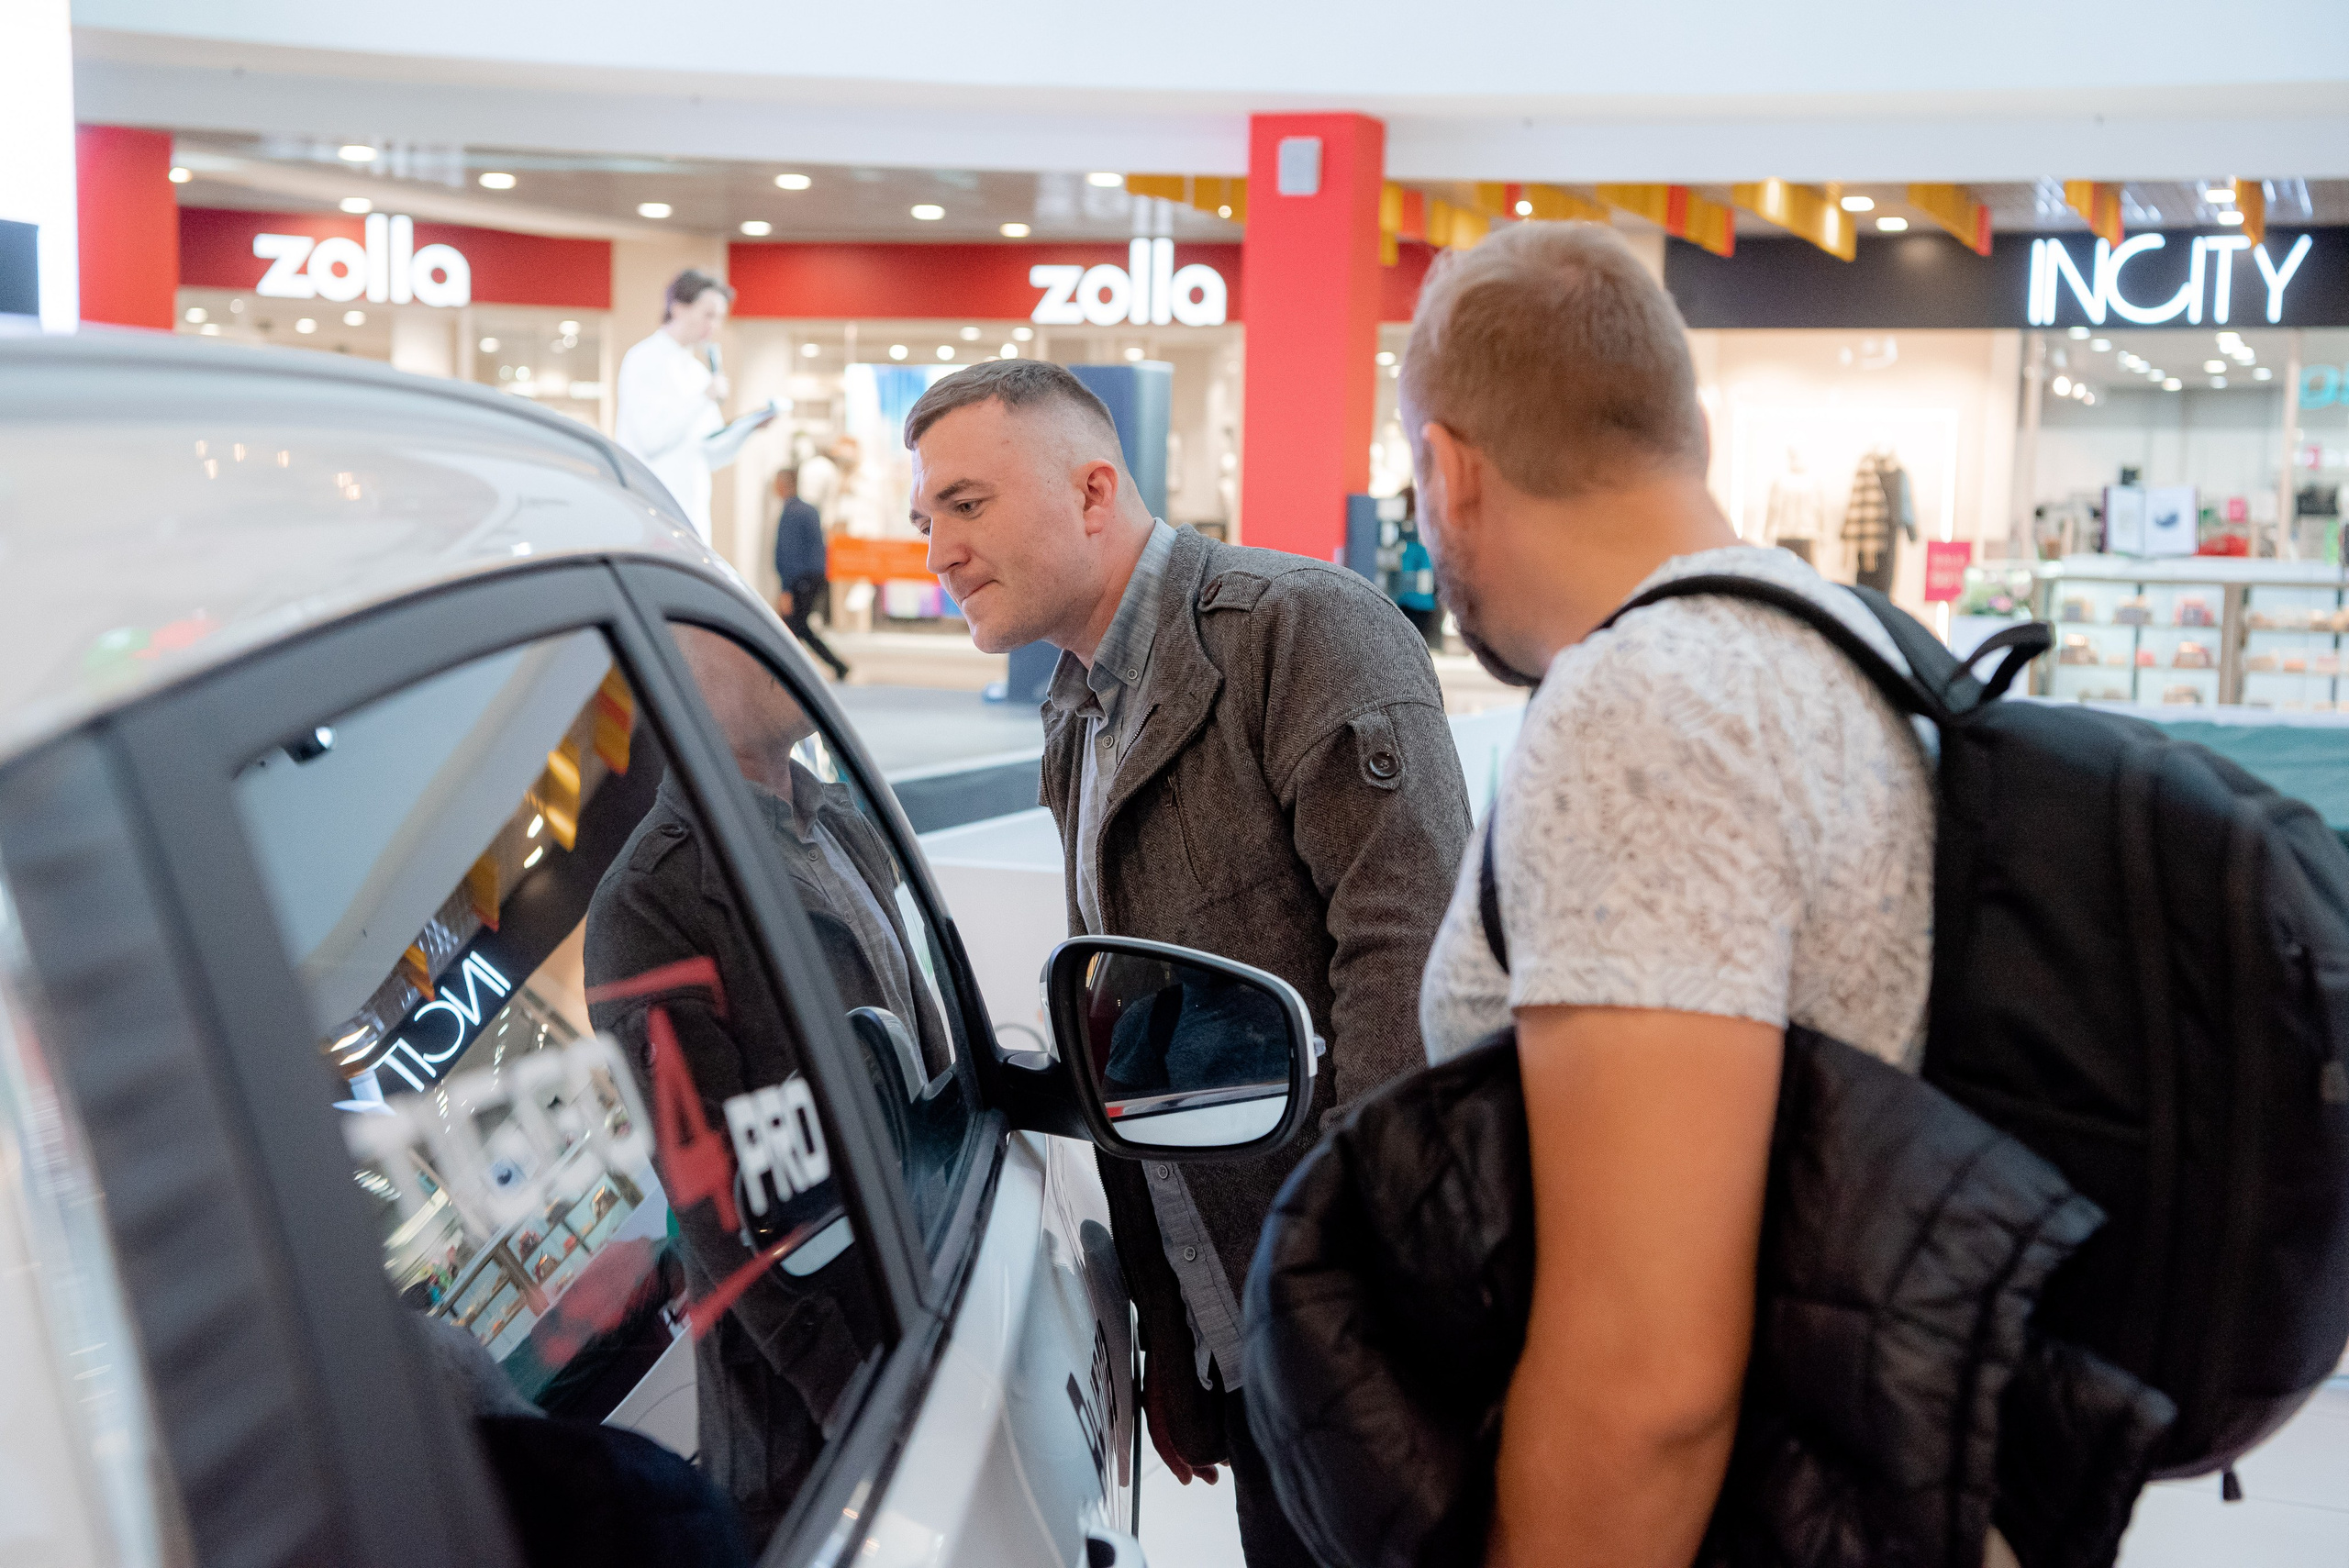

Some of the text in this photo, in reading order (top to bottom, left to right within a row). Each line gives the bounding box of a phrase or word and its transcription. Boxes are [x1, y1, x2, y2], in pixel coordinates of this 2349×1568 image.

[254, 214, 470, 307] zolla
[1030, 238, 1226, 326] zolla
[2029, 233, 2310, 324] INCITY
[648, 1006, 741, 1231] 4
[721, 1077, 830, 1217] PRO
